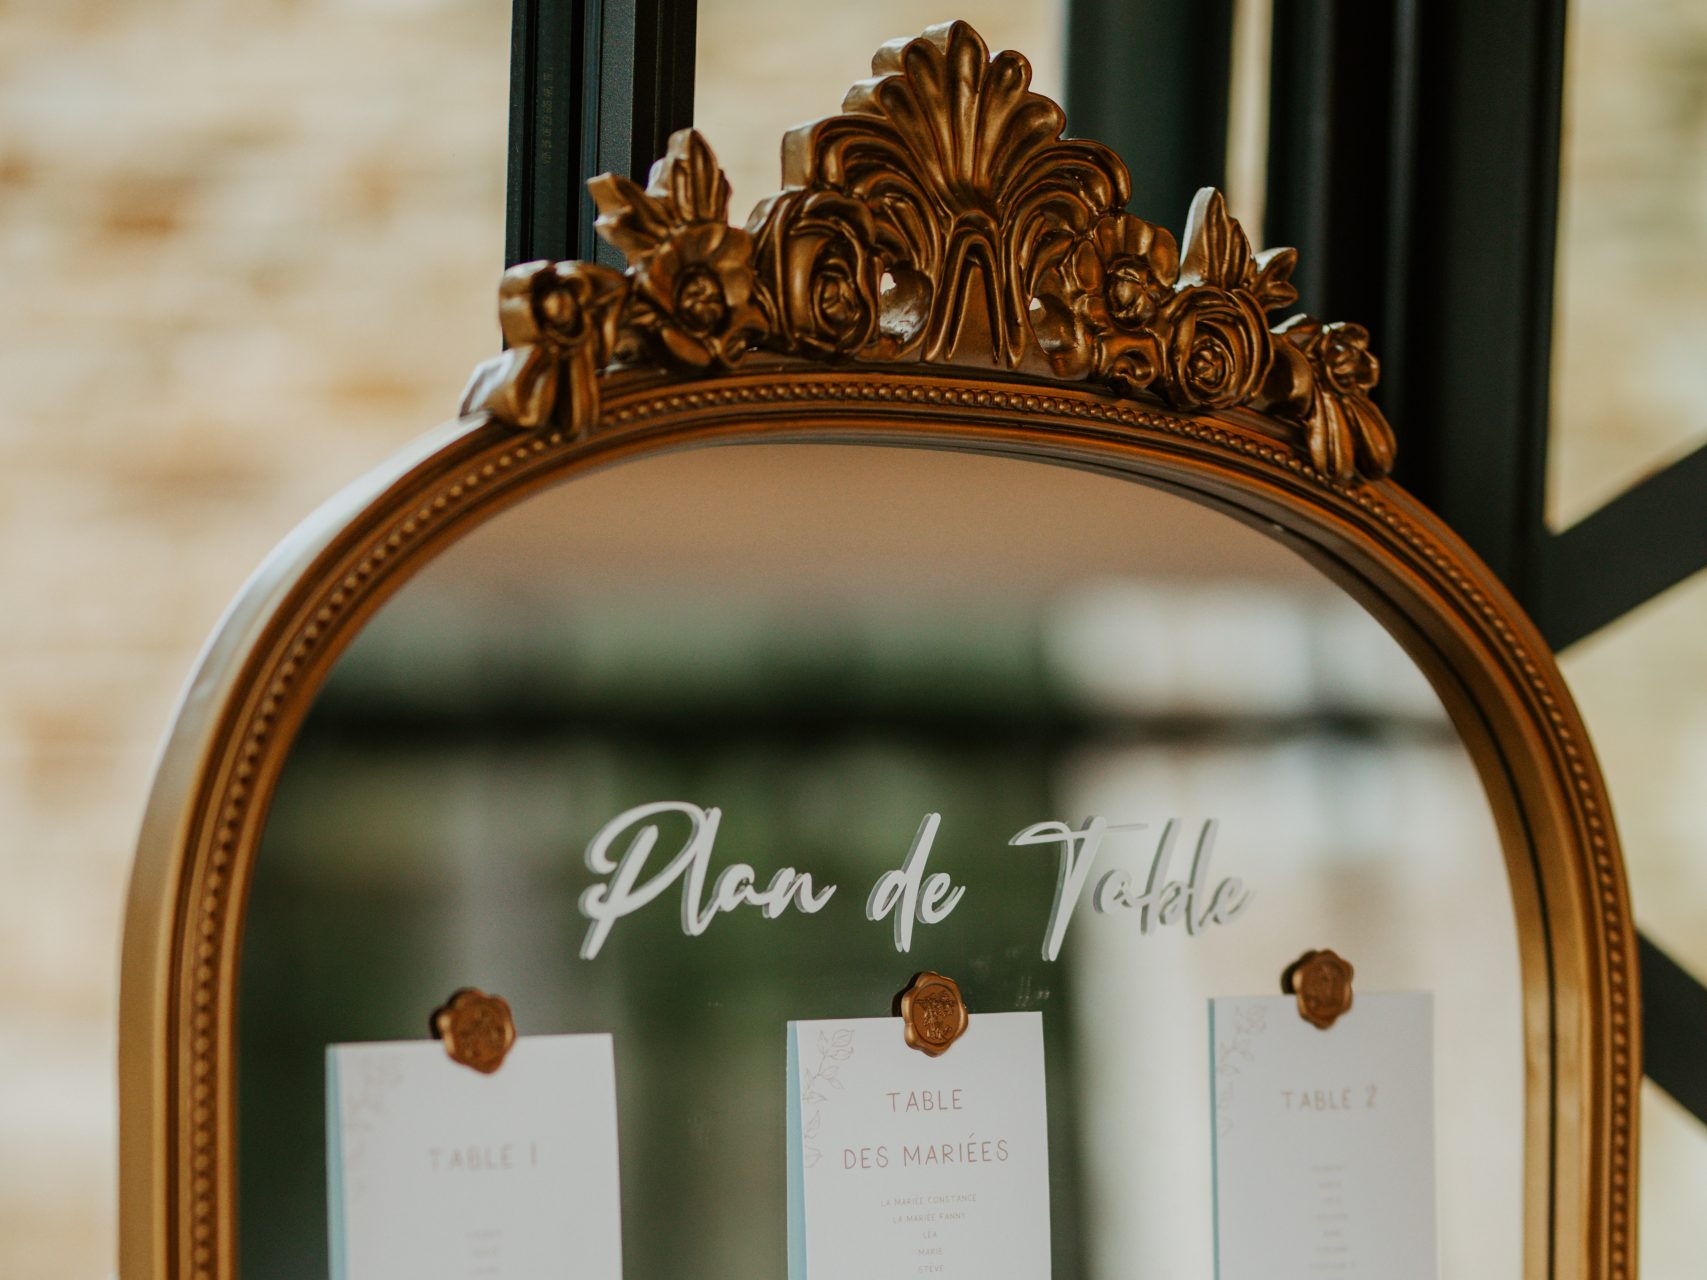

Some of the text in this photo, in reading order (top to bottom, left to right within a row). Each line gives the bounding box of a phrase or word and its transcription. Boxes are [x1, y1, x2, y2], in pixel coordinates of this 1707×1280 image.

[579, 801, 1256, 961] Plan de Table
[885, 1088, 963, 1112] TABLE
[1280, 1083, 1377, 1111] TABLE 2
[428, 1141, 537, 1171] TABLE 1
[843, 1132, 1009, 1170] DES MARIÉES
[927, 1193, 977, 1204] CONSTANCE
